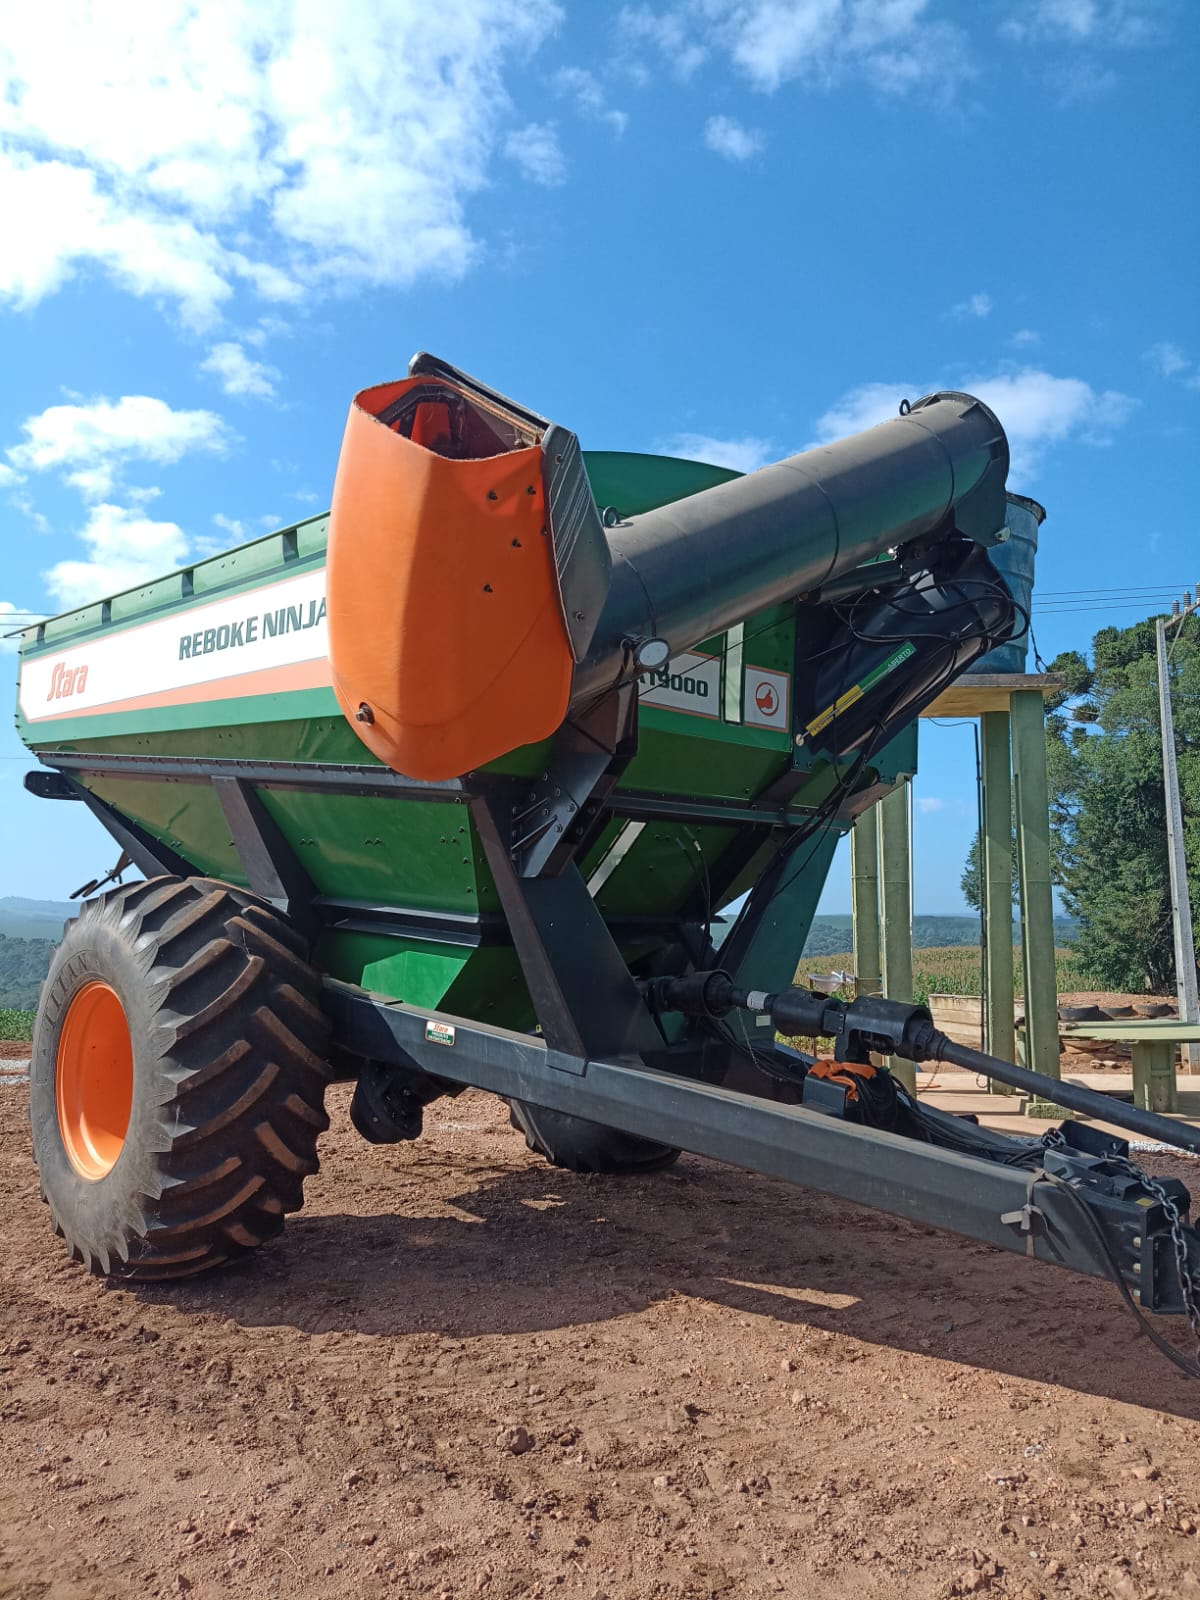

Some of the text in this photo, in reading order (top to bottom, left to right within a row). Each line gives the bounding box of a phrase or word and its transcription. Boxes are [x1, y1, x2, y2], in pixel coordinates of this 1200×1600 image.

[179, 597, 328, 660] REBOKE NINJA
[47, 662, 88, 702] Stara
